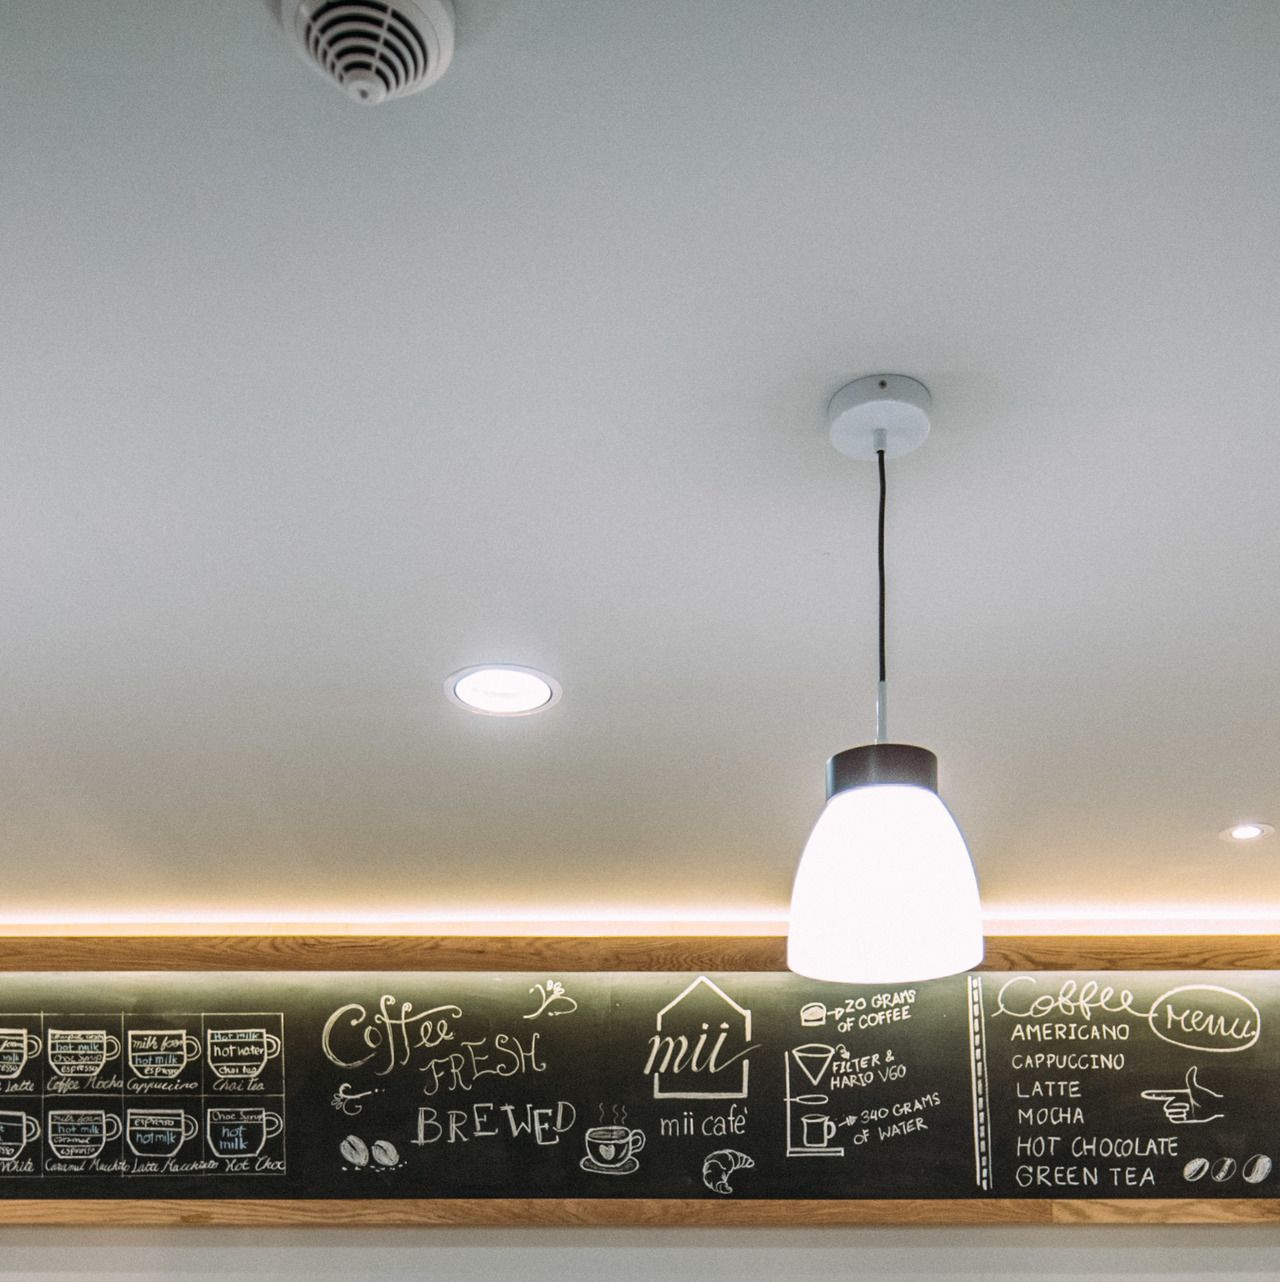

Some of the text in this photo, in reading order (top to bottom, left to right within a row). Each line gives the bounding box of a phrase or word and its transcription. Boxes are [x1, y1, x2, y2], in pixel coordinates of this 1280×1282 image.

[844, 989, 917, 1012] 20 GRAMS
[991, 975, 1158, 1020] Coffee
[837, 1005, 912, 1032] OF COFFEE
[322, 995, 462, 1075] Coffee
[1010, 1023, 1131, 1041] AMERICANO
[135, 1053, 178, 1064] hot milk
[214, 1045, 265, 1057] hot water
[643, 1021, 762, 1075] mii
[419, 1033, 547, 1096] FRESH
[832, 1049, 895, 1074] FILTER &
[1011, 1053, 1125, 1070] CAPPUCCINO
[47, 1075, 124, 1093] Coffee Mocha
[212, 1078, 266, 1091] Chai Tea
[830, 1064, 907, 1091] HARIO V60
[1016, 1080, 1082, 1098] LATTE
[860, 1091, 941, 1124] 340 GRAMS
[1018, 1107, 1085, 1125] MOCHA
[57, 1123, 76, 1134] hot
[222, 1125, 247, 1137] hot
[410, 1101, 577, 1147] BREWED
[660, 1111, 695, 1136] mii
[853, 1117, 929, 1145] OF WATER
[135, 1130, 177, 1144] hot milk
[219, 1138, 248, 1150] milk
[1017, 1136, 1179, 1158] HOT CHOCOLATE
[225, 1159, 250, 1173] Hot
[1015, 1165, 1155, 1188] GREEN TEA
